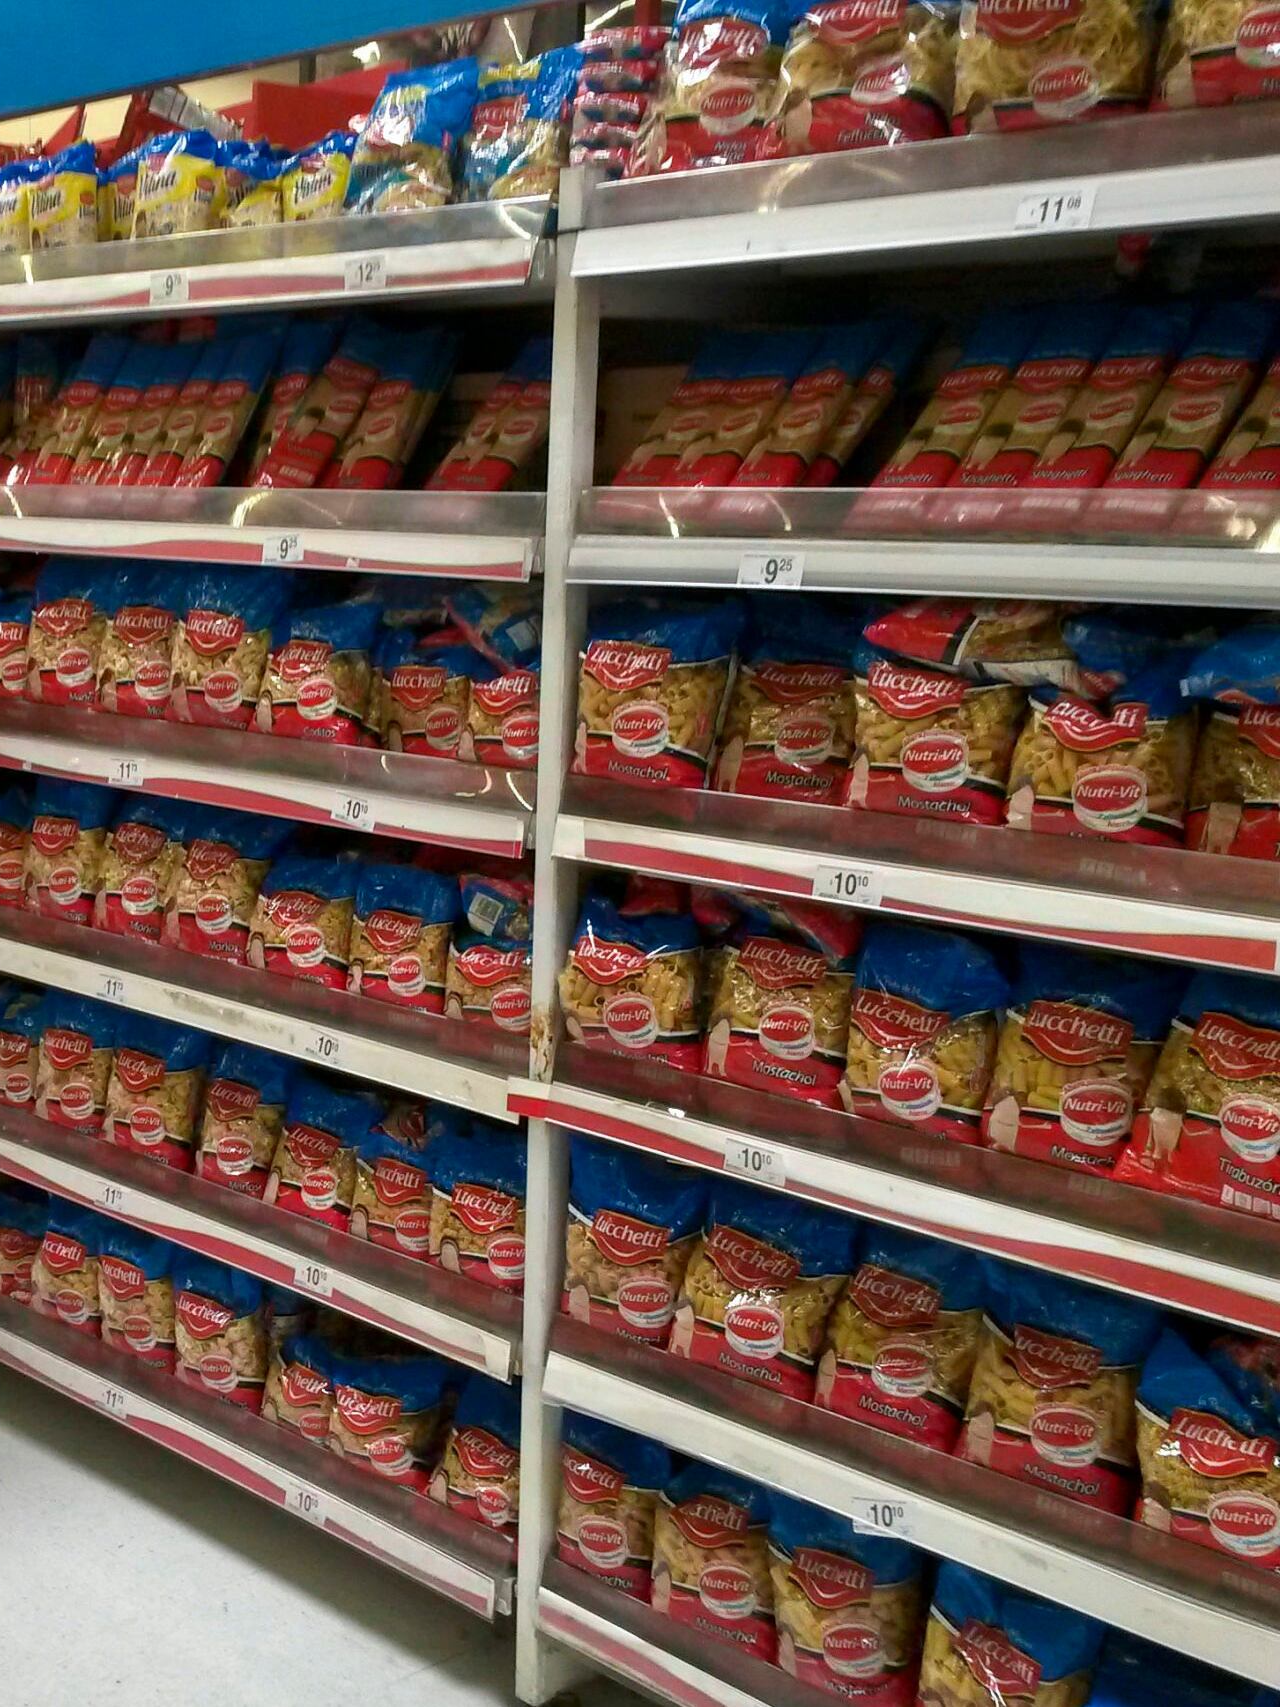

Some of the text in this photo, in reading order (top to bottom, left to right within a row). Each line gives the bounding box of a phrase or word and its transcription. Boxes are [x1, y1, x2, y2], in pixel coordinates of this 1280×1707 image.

[1240, 18, 1280, 37] Nutri-
[187, 619, 239, 639] Lucchetti
[591, 645, 663, 672] Lucchetti
[391, 671, 444, 688] Lucchetti
[760, 666, 838, 688] Lucchetti
[871, 663, 960, 700] Lucchetti
[505, 725, 538, 740] Nutri-V
[615, 716, 664, 734] Nutri-Vit
[904, 743, 963, 765] Nutri-Vit
[608, 758, 668, 781] Mostachol
[765, 770, 834, 790] Mostachol
[1076, 783, 1141, 800] Nutri-Vit
[897, 795, 972, 816] Mostachol
[606, 1009, 650, 1024] Nutri-Vit
[763, 1017, 810, 1034] Nutri-Vit
[855, 996, 942, 1035] Lucchetti
[1026, 1009, 1124, 1046] Lucchetti
[1197, 1019, 1280, 1062] Lucchett
[752, 1059, 818, 1087] Mostachol
[881, 1074, 932, 1092] Nutri-Vit
[1063, 1096, 1126, 1115] Nutri-Vit
[1224, 1109, 1279, 1133] Nutri-Vit
[1051, 1145, 1116, 1169] Mostach
[375, 1168, 420, 1188] Lucchetti
[395, 1217, 429, 1230] Nutri-V
[595, 1215, 664, 1249] Lucchetti
[712, 1229, 795, 1280] Lucchetti
[621, 1291, 670, 1305] Nutri-Vit
[857, 1267, 937, 1315] Lucchetti
[728, 1312, 780, 1333] Nutri-Vit
[1016, 1335, 1098, 1371] Lucchetti
[858, 1394, 927, 1428] Mostachol
[1034, 1417, 1096, 1438] Nutri-Vit
[1024, 1463, 1100, 1496] Mostachol
[1214, 1509, 1275, 1530] Nutri-Vit
[579, 1526, 624, 1544] Nutri-Vit
[798, 1552, 866, 1590] Lucchetti
[701, 1575, 751, 1592] Nutri-Vit
[824, 1635, 879, 1650] Nutri-Vit
